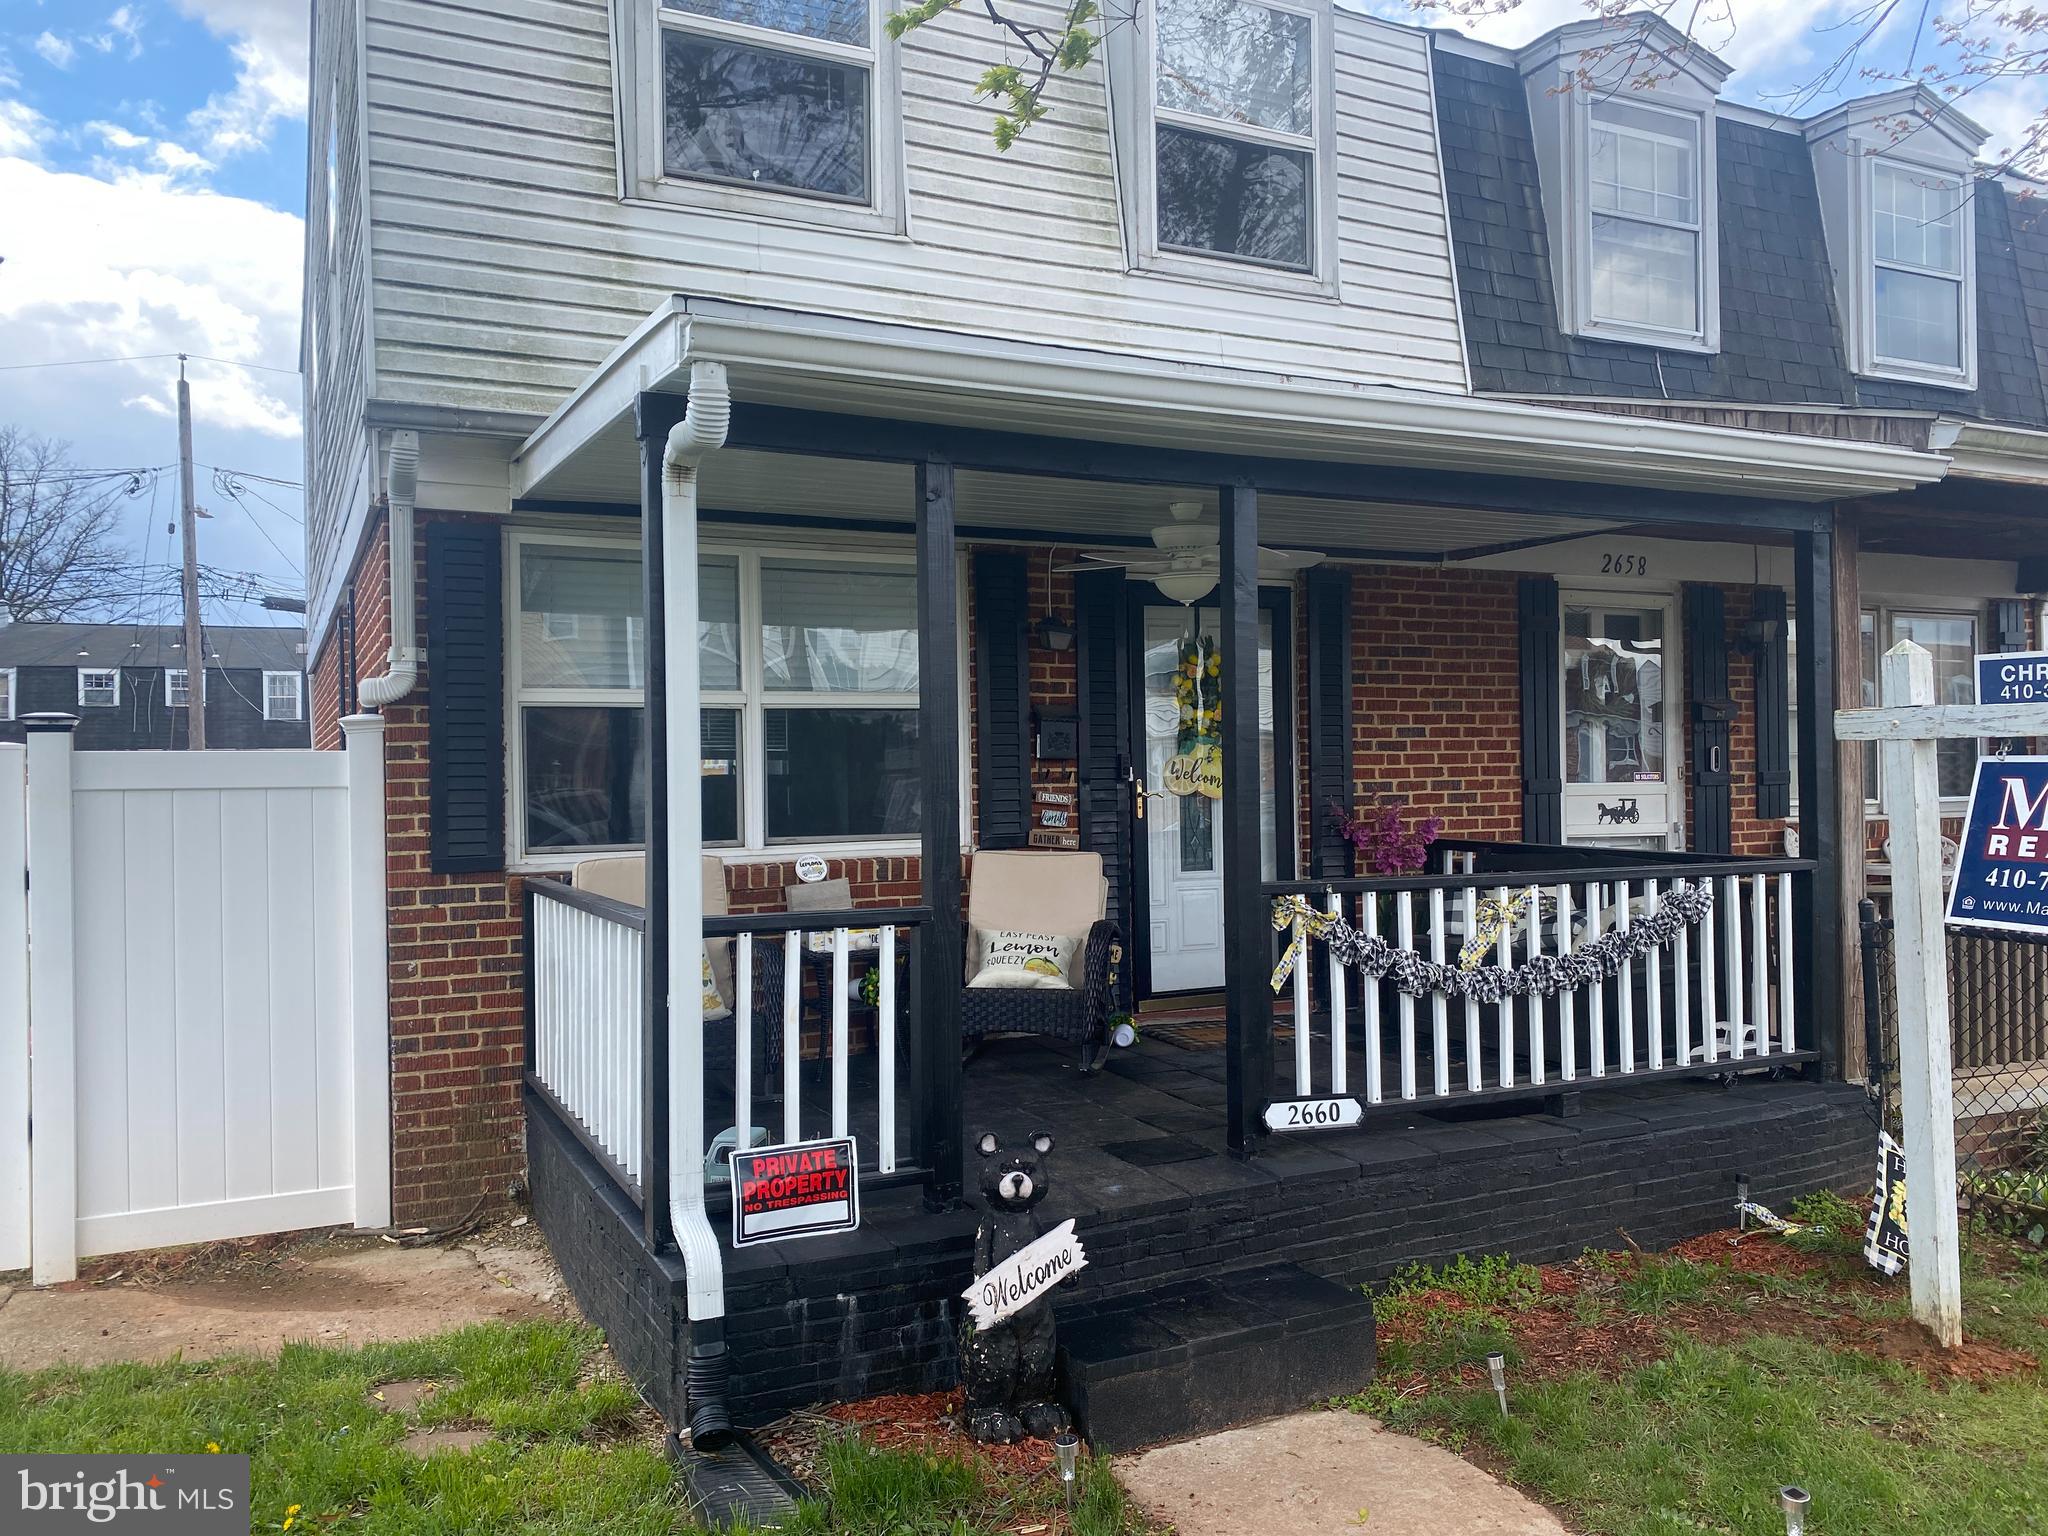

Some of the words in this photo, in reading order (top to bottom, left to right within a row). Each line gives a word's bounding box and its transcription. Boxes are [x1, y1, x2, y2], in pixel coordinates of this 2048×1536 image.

[1601, 553, 1646, 576] 2658
[1170, 757, 1222, 789] Welcom
[1041, 793, 1070, 803] FRIENDS
[1033, 833, 1060, 845] GATHER
[1062, 837, 1076, 846] here
[1988, 834, 2048, 858] RE
[1985, 867, 2048, 891] 410-7
[1000, 931, 1023, 939] EASY
[987, 955, 1025, 967] SQUEEZY
[990, 942, 1059, 957] Lemon
[1288, 1102, 1340, 1125] 2660
[752, 1149, 837, 1179] PRIVATE
[742, 1169, 848, 1202] PROPERTY
[744, 1203, 762, 1213] NO
[767, 1190, 848, 1209] TRESPASSING
[983, 1248, 1072, 1314] Welcome
